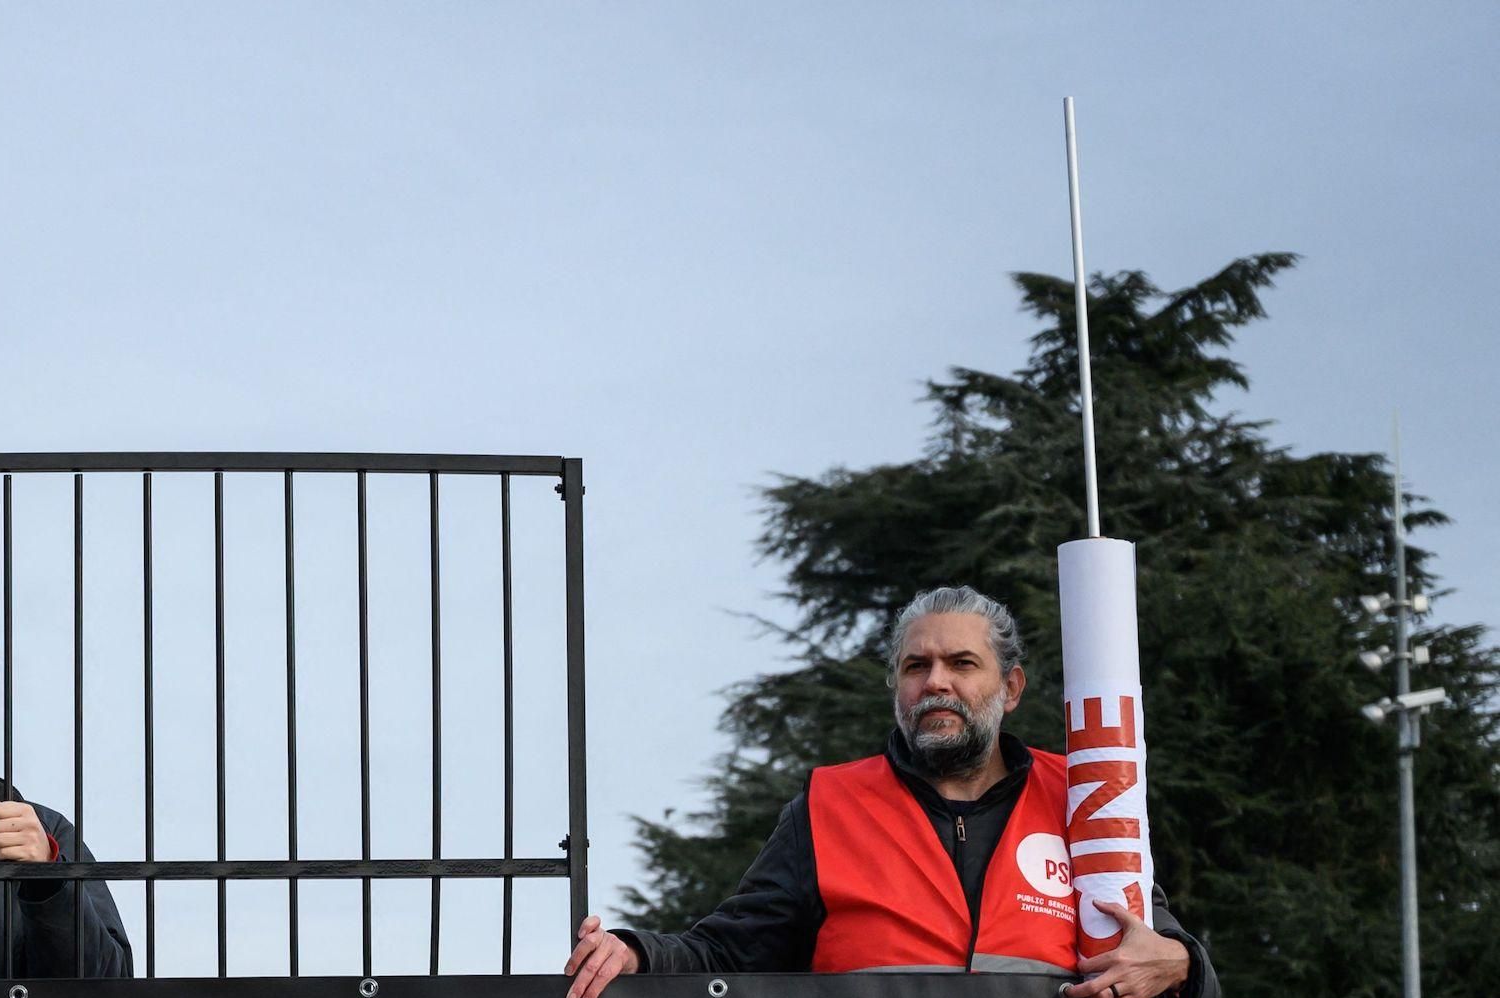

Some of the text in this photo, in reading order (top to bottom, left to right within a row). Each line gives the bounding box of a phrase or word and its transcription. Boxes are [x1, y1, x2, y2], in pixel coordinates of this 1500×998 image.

[1045, 859, 1073, 887] PSI
[1017, 894, 1044, 904] PUBLIC
[1021, 903, 1075, 923] INTERNATIONAL
